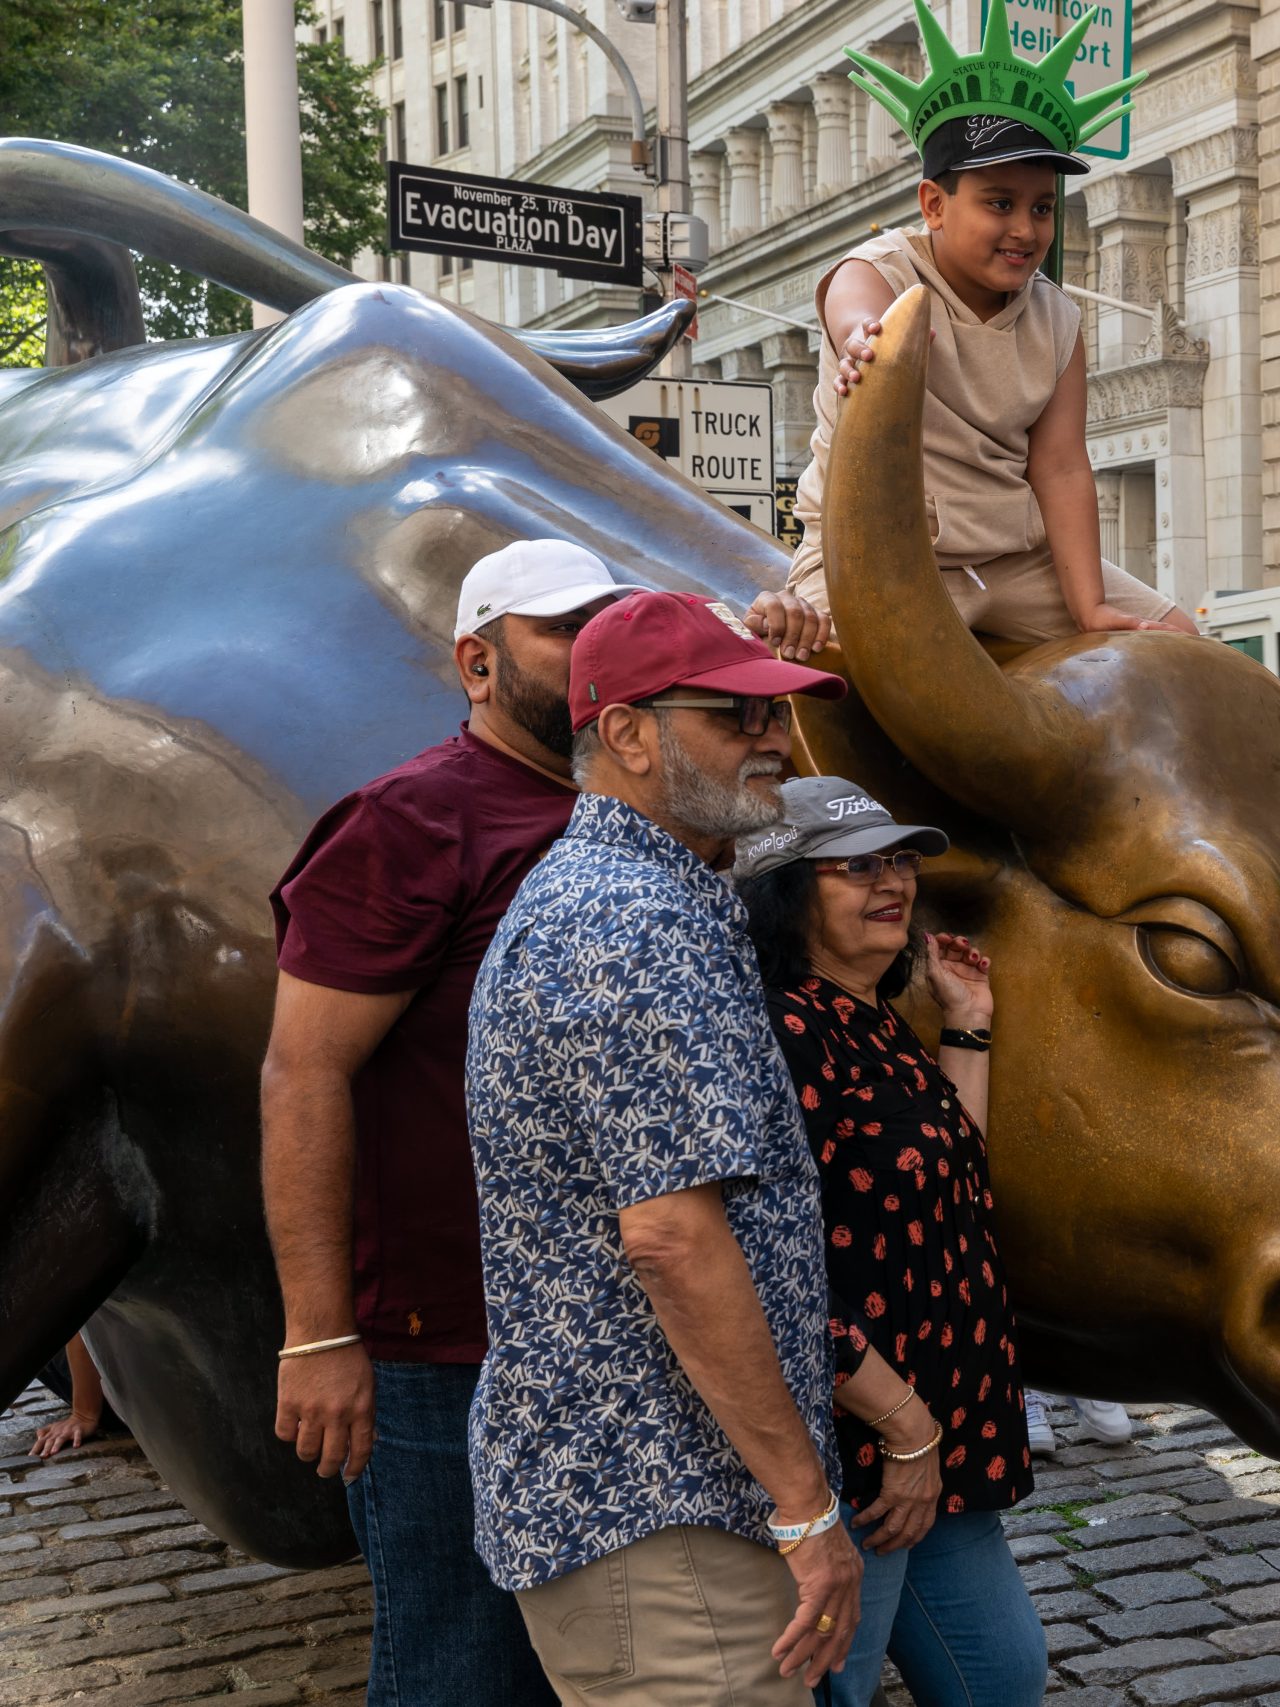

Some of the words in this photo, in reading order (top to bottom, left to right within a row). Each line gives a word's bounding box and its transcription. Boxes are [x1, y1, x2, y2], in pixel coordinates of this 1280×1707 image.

[1004, 0, 1112, 28] wntown
[1010, 21, 1111, 68] Heliort
[953, 61, 986, 77] STATUE
[988, 60, 1001, 70] OF
[1003, 62, 1045, 84] LIBERTY
[454, 185, 513, 207] November
[547, 199, 574, 215] 1783
[405, 191, 561, 244] Evacuation
[567, 215, 617, 258] Day
[496, 235, 534, 253] PLAZA
[691, 410, 762, 438] TRUCK
[692, 455, 762, 481] ROUTE
